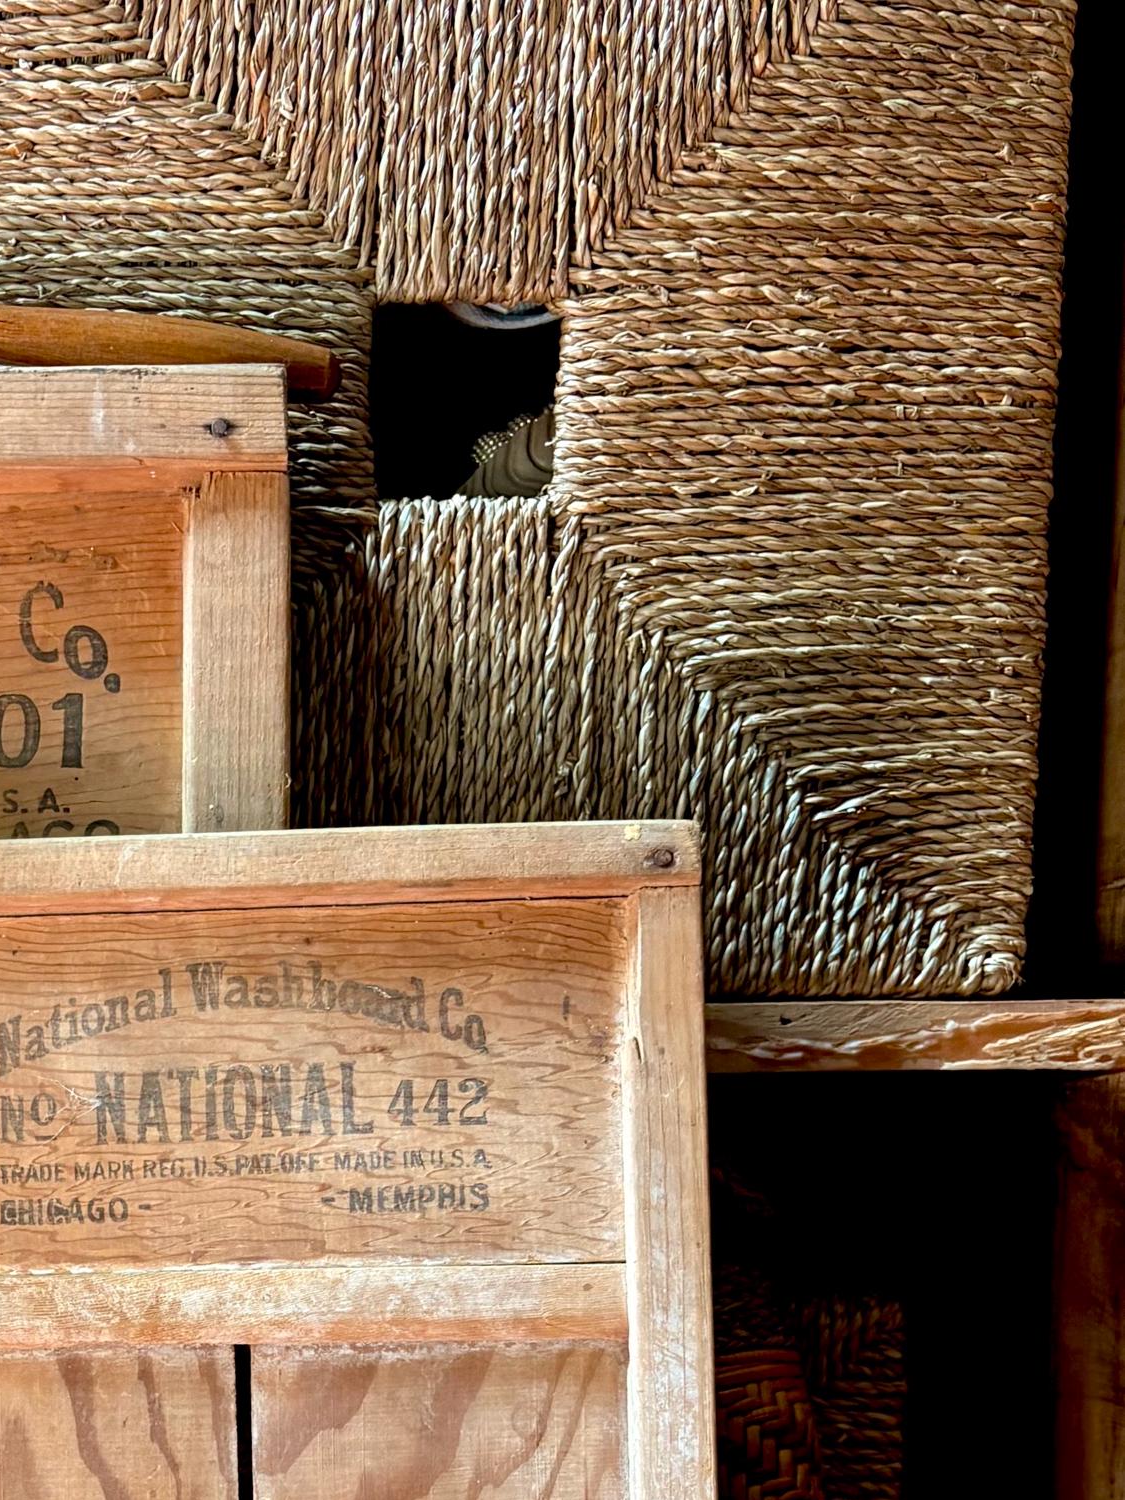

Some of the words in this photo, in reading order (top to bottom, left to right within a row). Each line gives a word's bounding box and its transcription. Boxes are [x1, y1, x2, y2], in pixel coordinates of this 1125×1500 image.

[18, 580, 121, 694] Co.
[93, 1061, 374, 1145] NATIONAL
[386, 1076, 490, 1127] 442
[0, 1163, 66, 1185] TRADE
[74, 1158, 135, 1181] MARK
[333, 1150, 397, 1172] MADE
